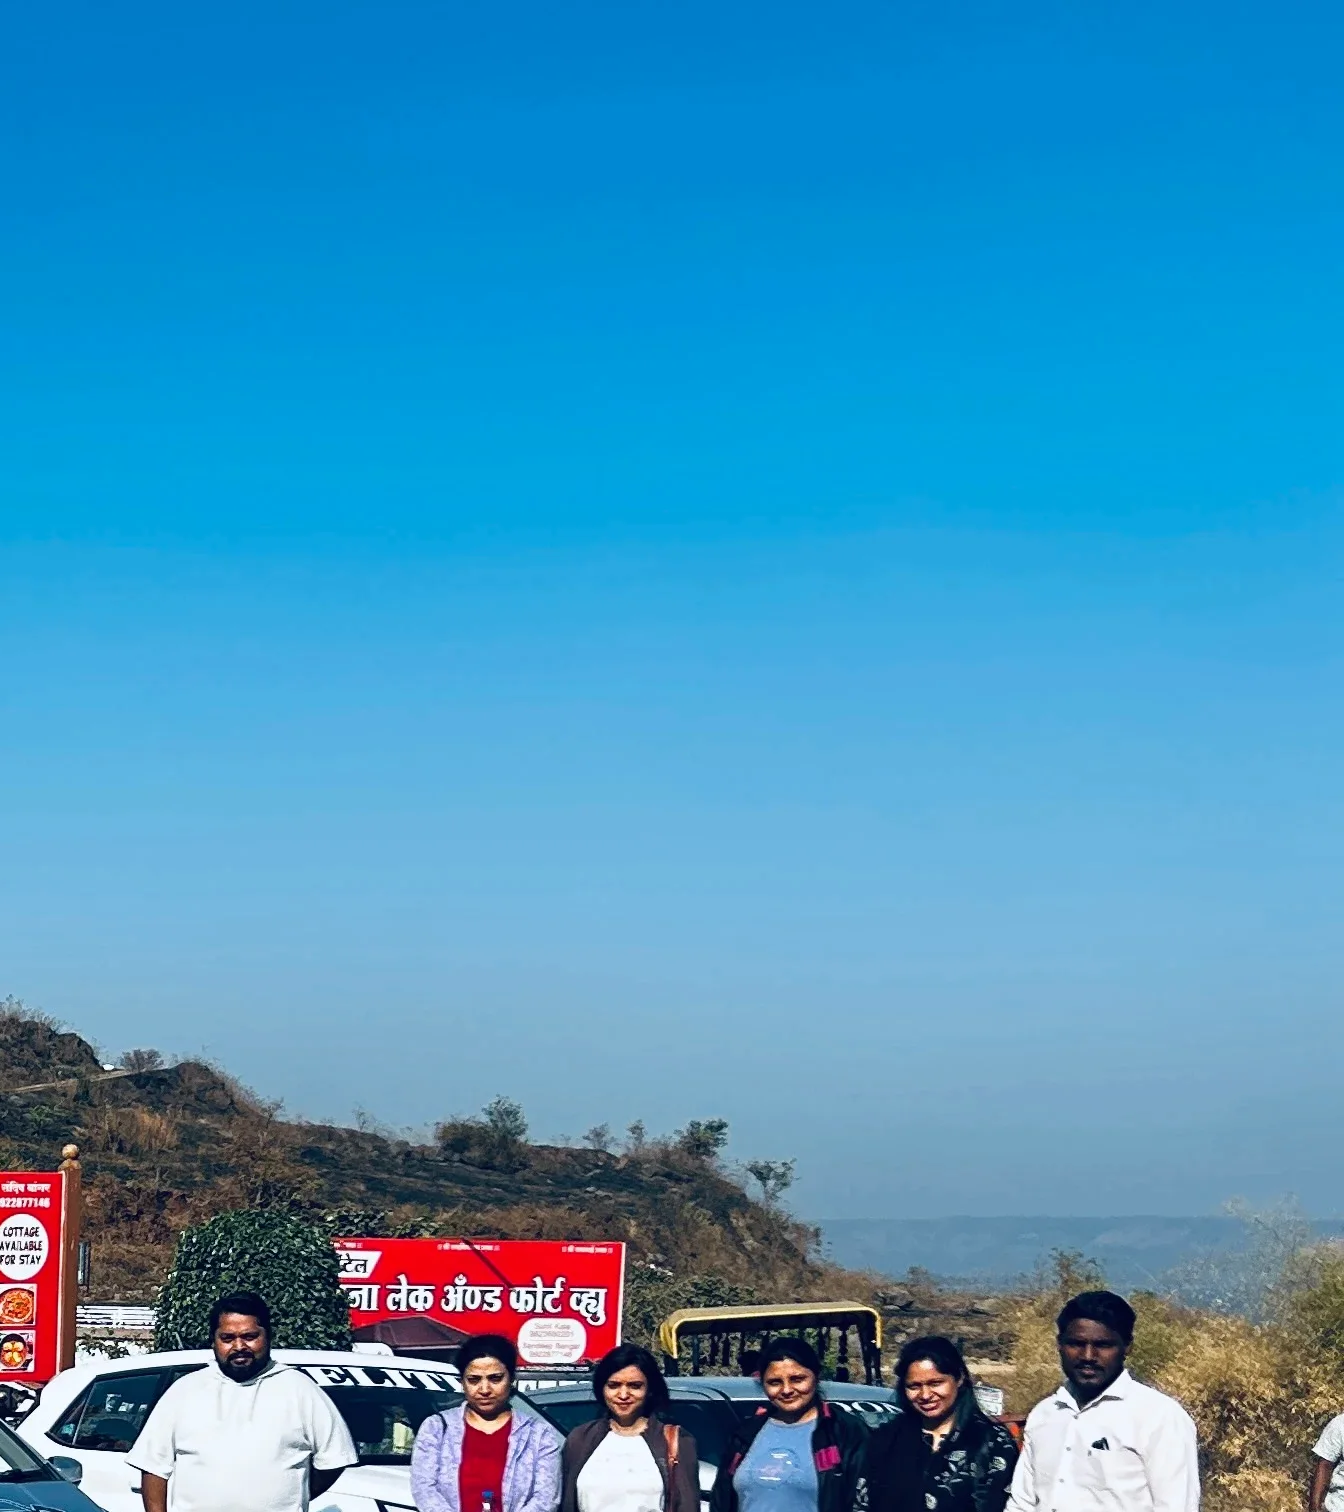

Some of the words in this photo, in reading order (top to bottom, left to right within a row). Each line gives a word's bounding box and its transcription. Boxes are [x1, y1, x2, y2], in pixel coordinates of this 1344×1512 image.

[2, 1226, 40, 1238] COTTAGE
[0, 1254, 16, 1265] FOR
[18, 1254, 42, 1265] STAY
[339, 1252, 369, 1274] टेल
[385, 1273, 436, 1312] लेक
[509, 1275, 566, 1313] फोर्ट
